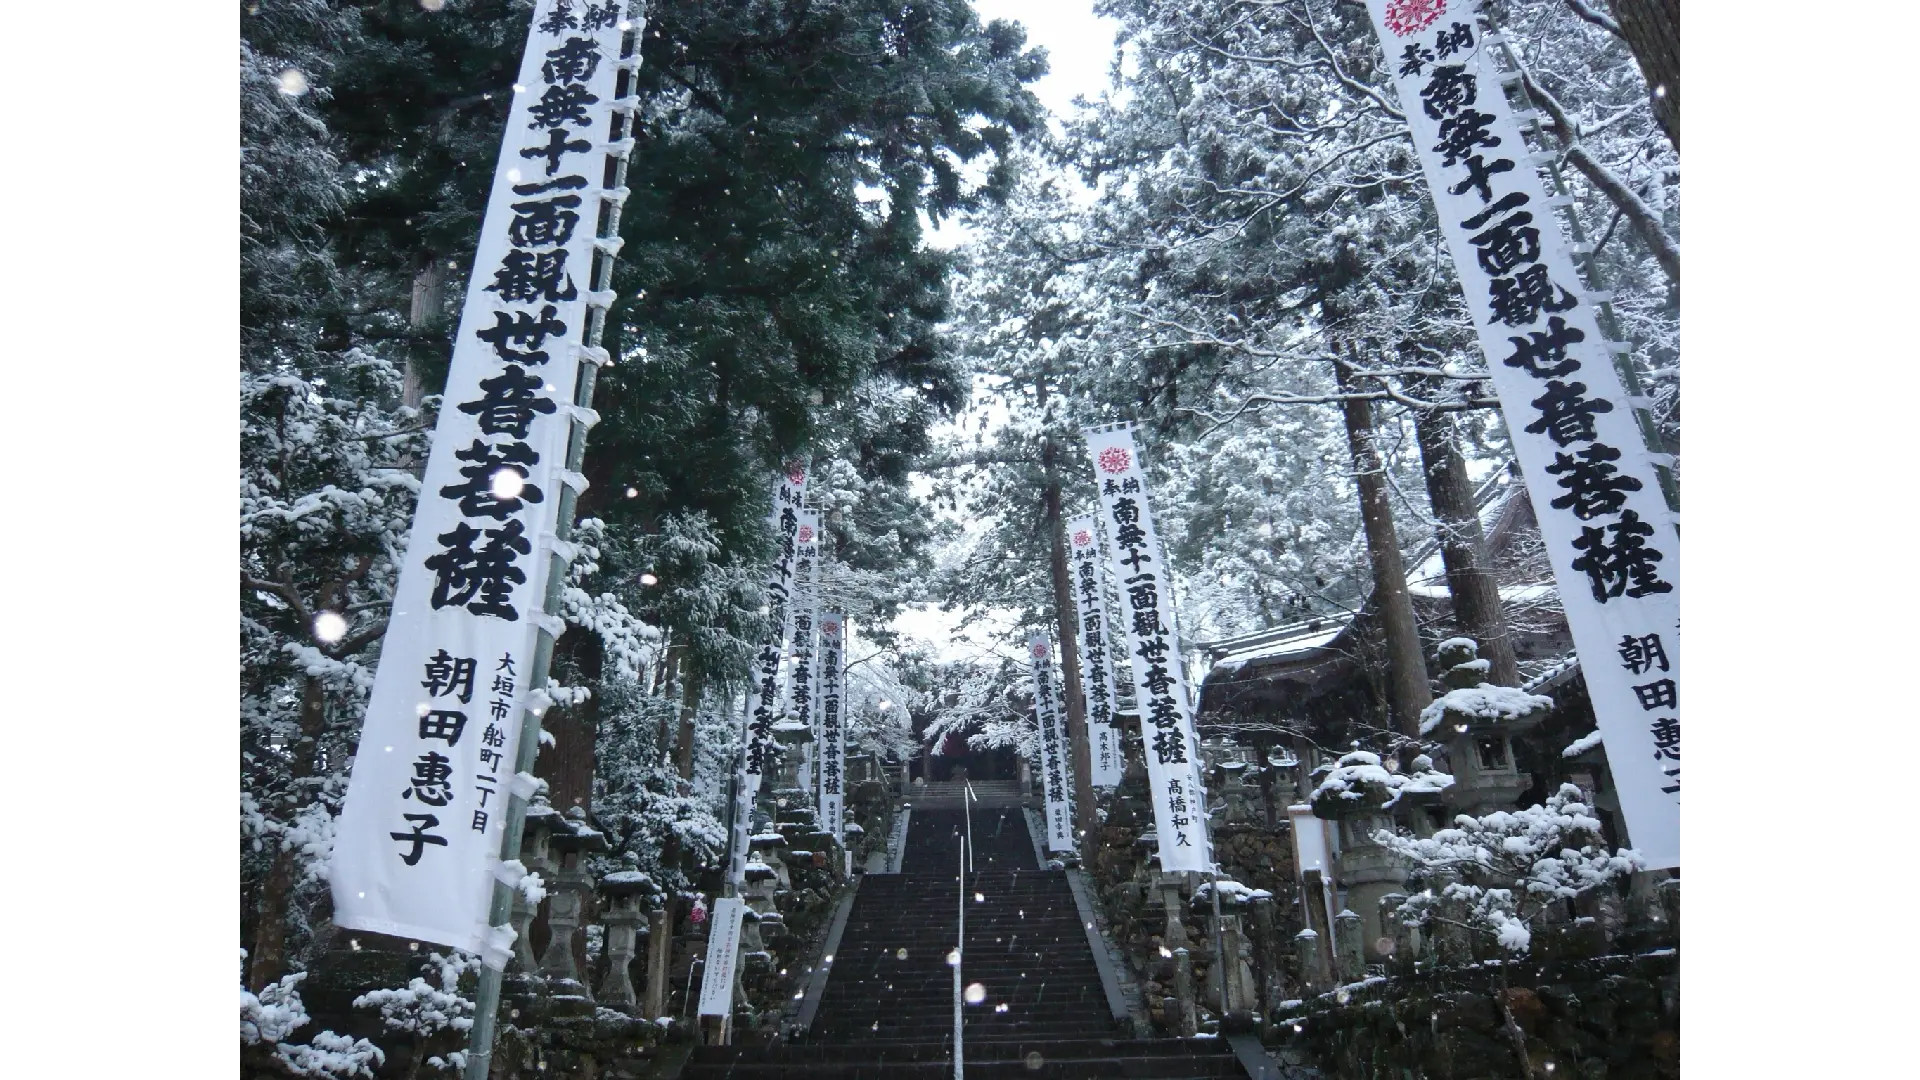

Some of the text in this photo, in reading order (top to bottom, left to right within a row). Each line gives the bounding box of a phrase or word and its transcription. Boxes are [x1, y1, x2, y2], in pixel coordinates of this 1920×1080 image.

[472, 652, 517, 835] 大垣市船町一丁目
